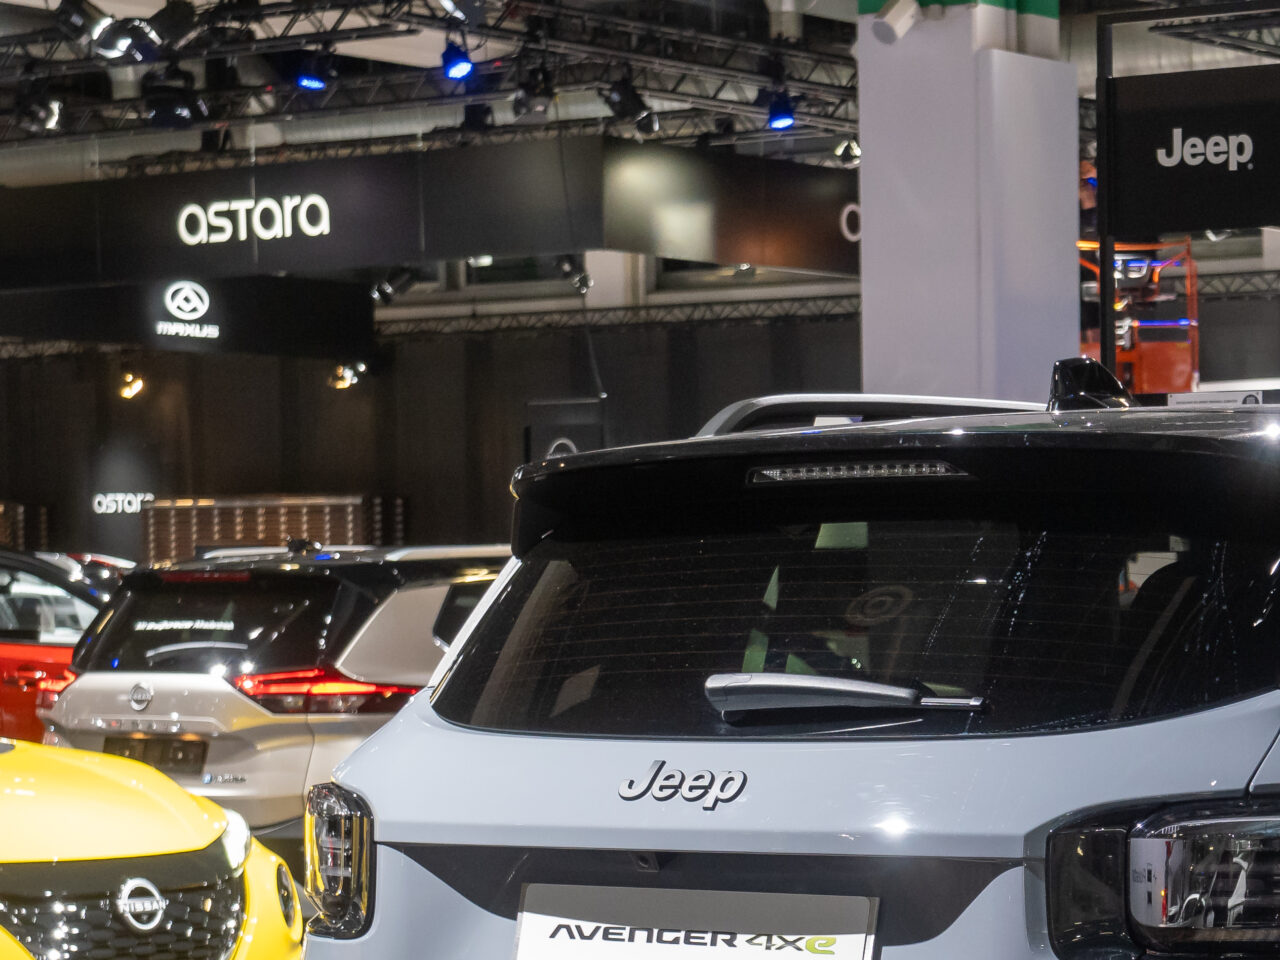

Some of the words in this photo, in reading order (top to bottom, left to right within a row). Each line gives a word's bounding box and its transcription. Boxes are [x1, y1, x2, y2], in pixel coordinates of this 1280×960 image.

[1156, 128, 1254, 171] Jeep
[178, 193, 331, 246] astara
[617, 759, 749, 811] Jeep
[119, 898, 167, 914] NISSAN
[548, 923, 738, 949] AVENGER
